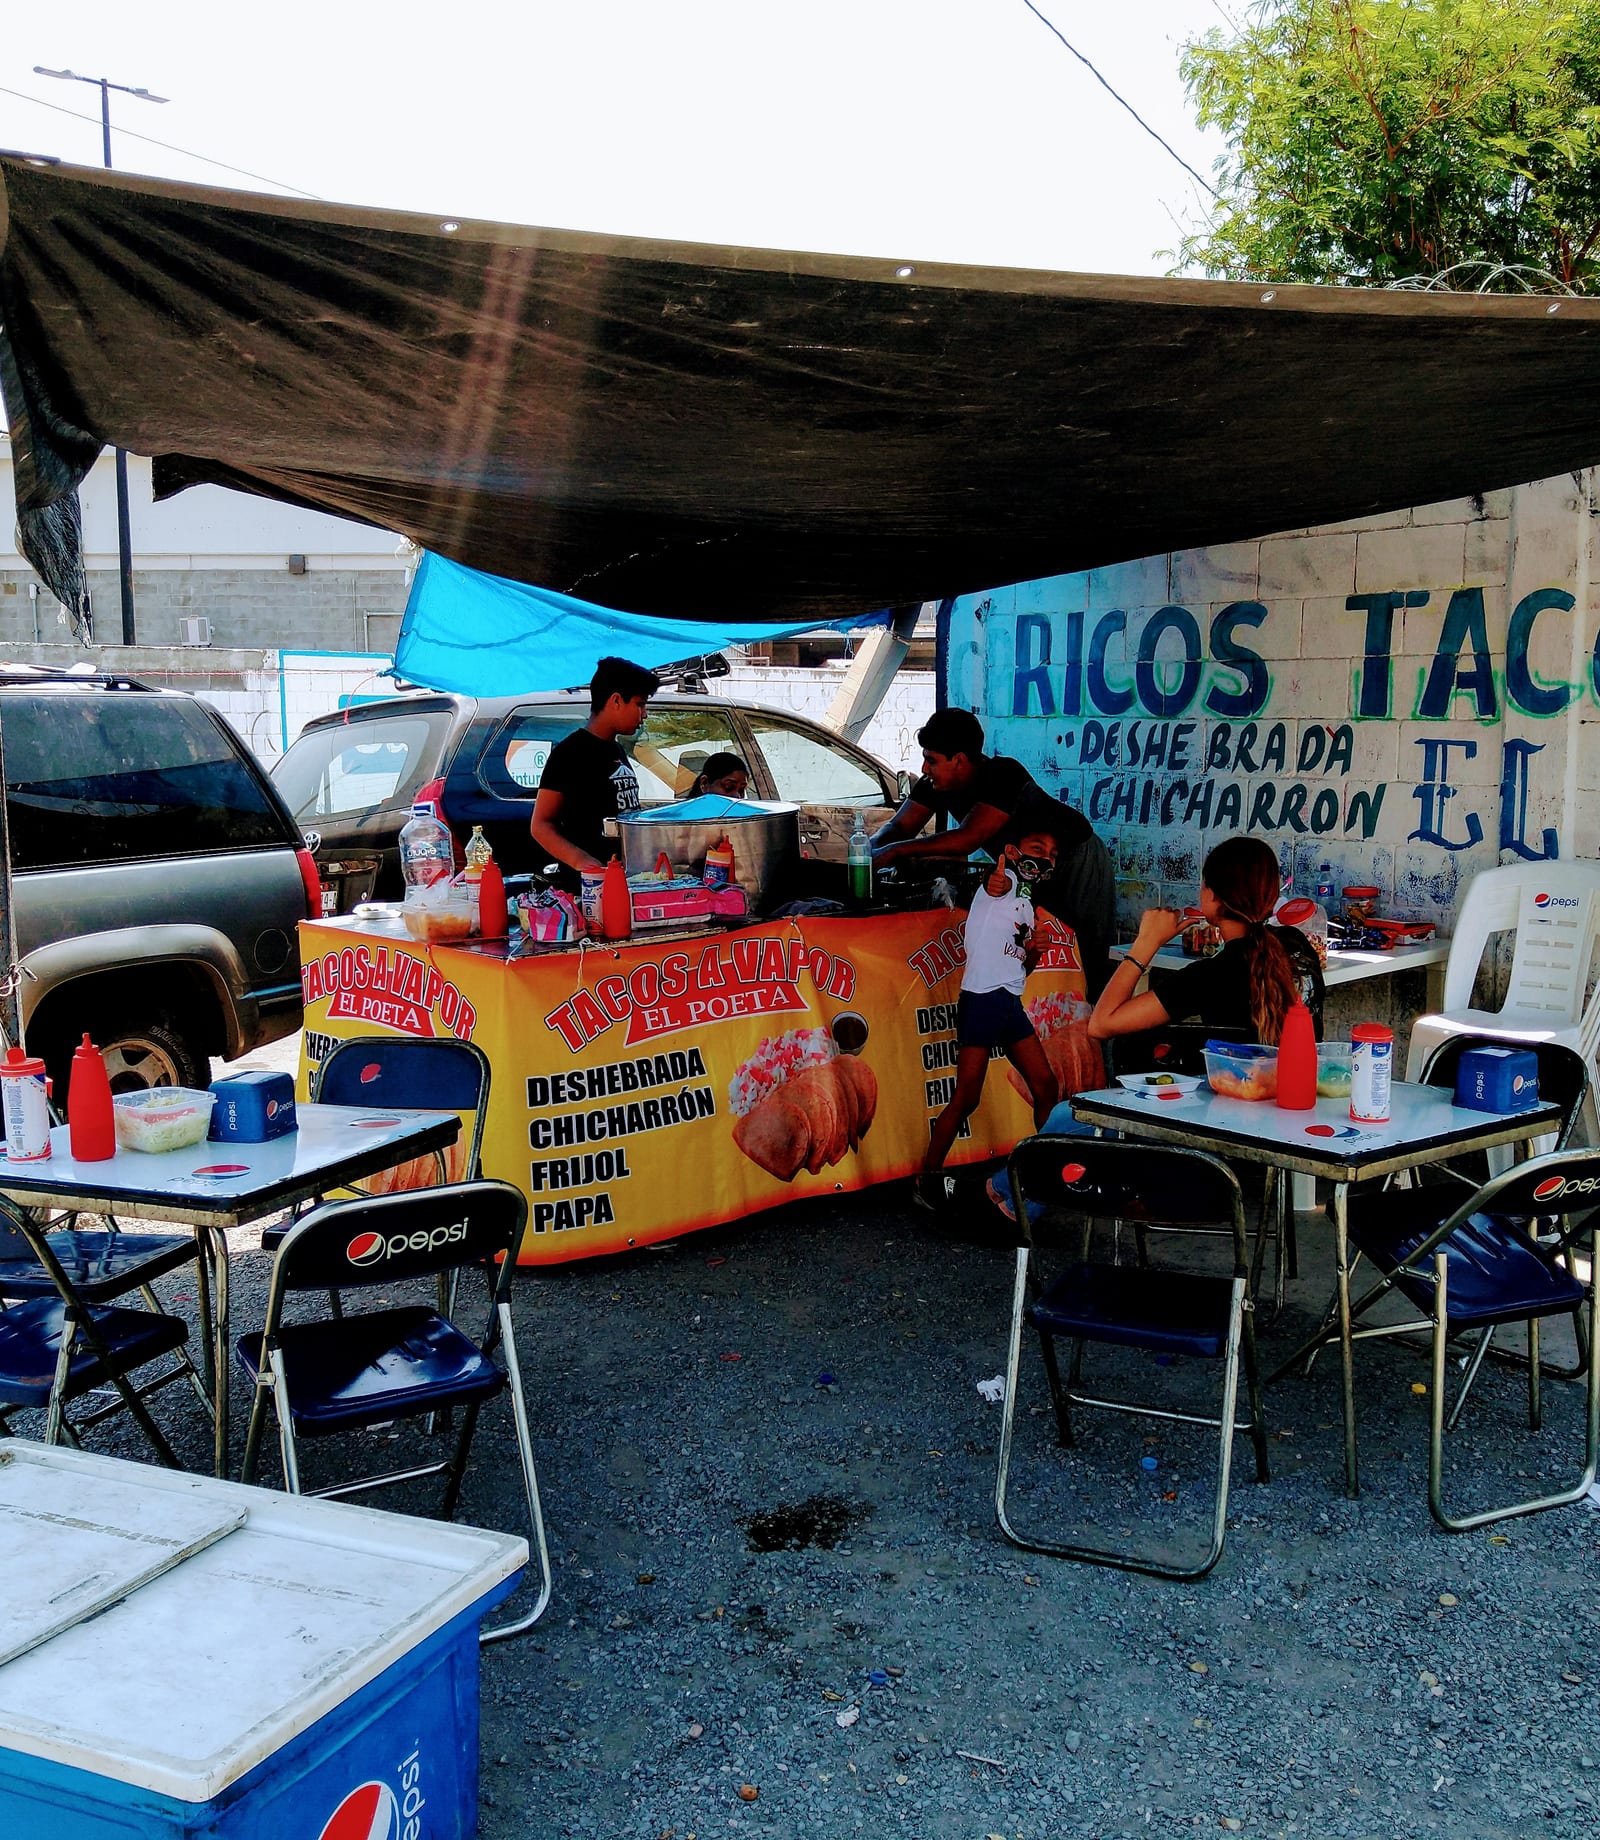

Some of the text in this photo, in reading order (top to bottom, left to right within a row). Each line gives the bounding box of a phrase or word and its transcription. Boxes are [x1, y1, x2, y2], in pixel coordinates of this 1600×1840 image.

[1012, 587, 1600, 719] RICOS TAC
[1088, 776, 1387, 839] CHICHARRON
[1551, 896, 1580, 908] pepsi
[301, 945, 477, 1040] TACOS A VAPOR
[339, 992, 422, 1030] EL POETA
[545, 938, 856, 1053] TACOS A VAPOR
[641, 986, 790, 1033] EL POETA
[527, 1047, 706, 1109] DESHEBRADA
[1475, 1071, 1485, 1100] pepsi
[1523, 1076, 1537, 1089] pepsi
[228, 1100, 237, 1131] pepsi
[278, 1100, 294, 1113] pepsi
[528, 1086, 715, 1150] CHICHARRÓN
[531, 1148, 630, 1192] FRIJOL
[533, 1193, 615, 1234] PAPA
[386, 1217, 468, 1259] pepsi
[397, 1749, 426, 1840] epsi
